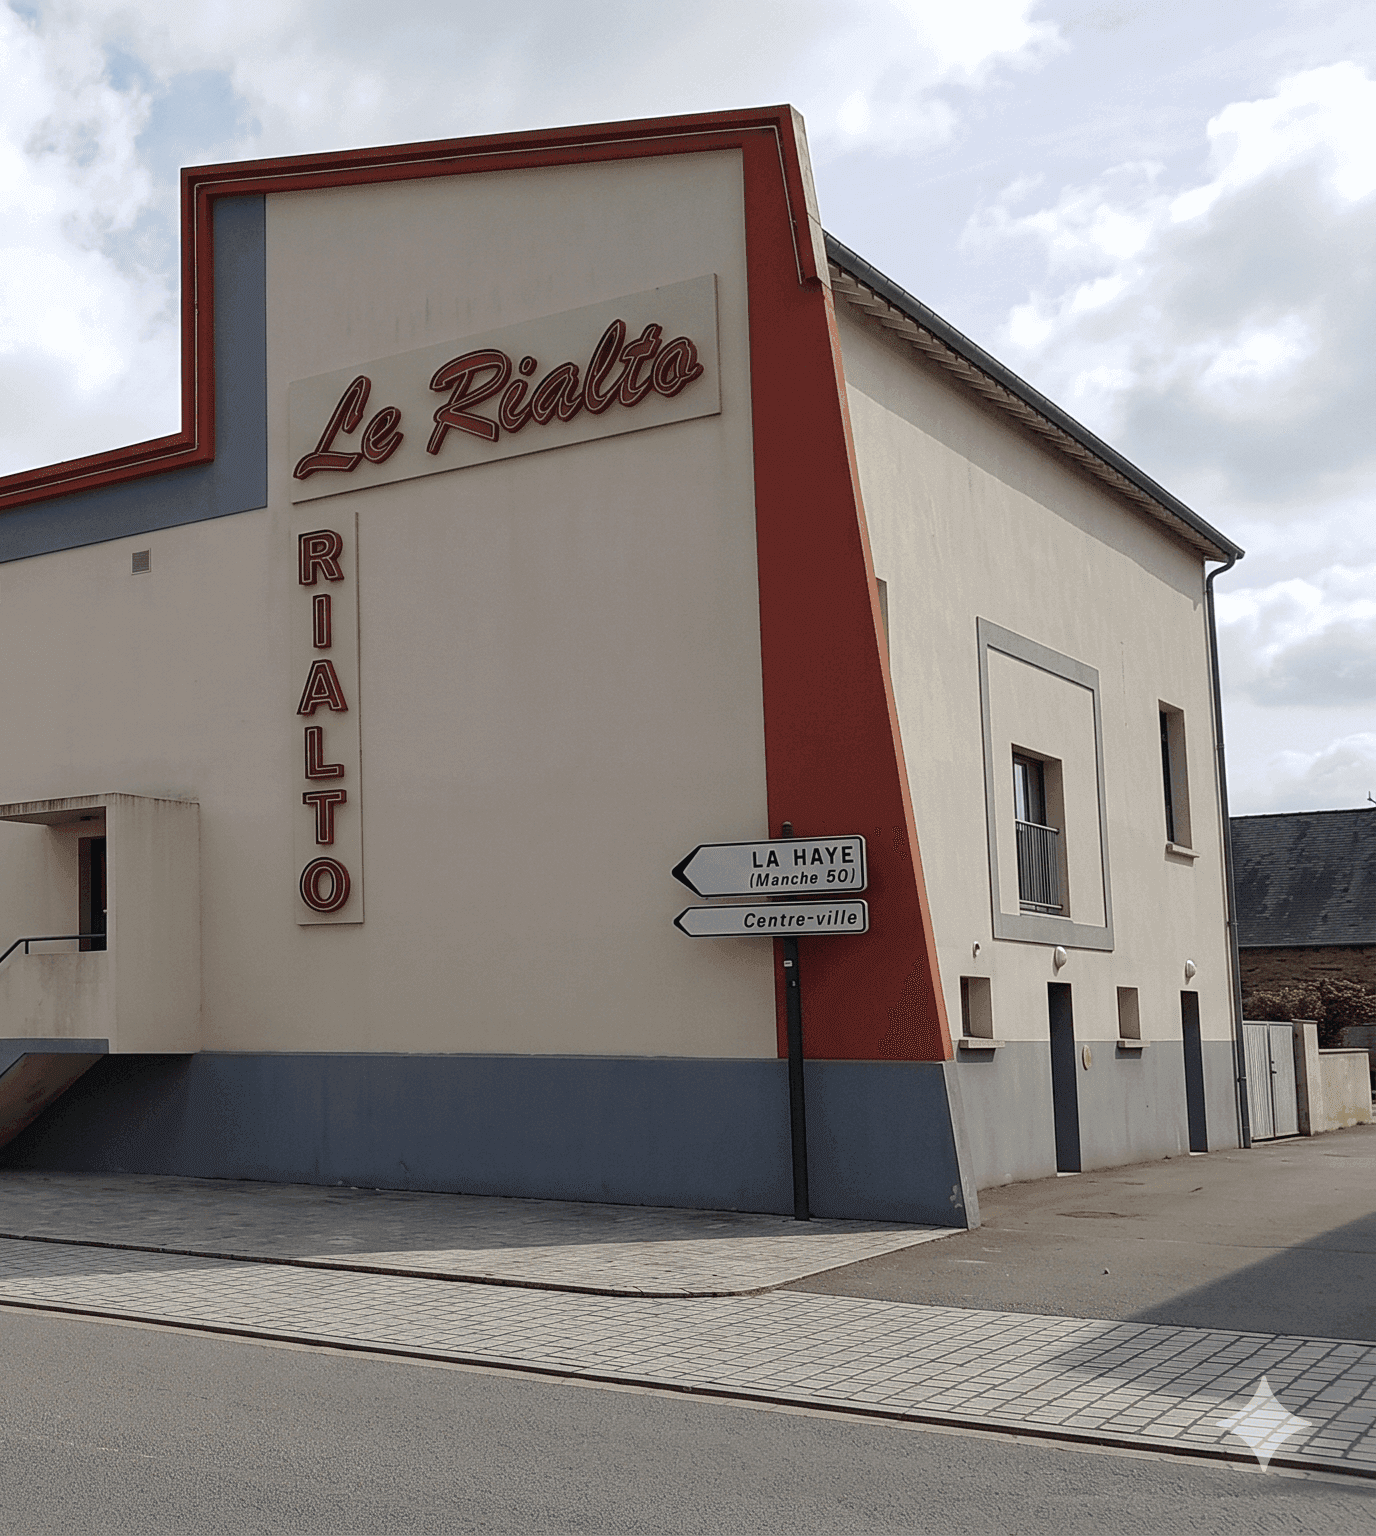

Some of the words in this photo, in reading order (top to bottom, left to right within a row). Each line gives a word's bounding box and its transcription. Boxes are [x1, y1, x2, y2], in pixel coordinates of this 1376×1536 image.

[293, 375, 404, 479] Le
[426, 319, 704, 455] Rialto
[296, 529, 351, 913] RIALTO
[752, 850, 780, 868] LA
[793, 846, 854, 866] HAYE
[749, 872, 819, 888] (Manche
[826, 868, 856, 884] 50)
[743, 910, 858, 928] Centre-ville
